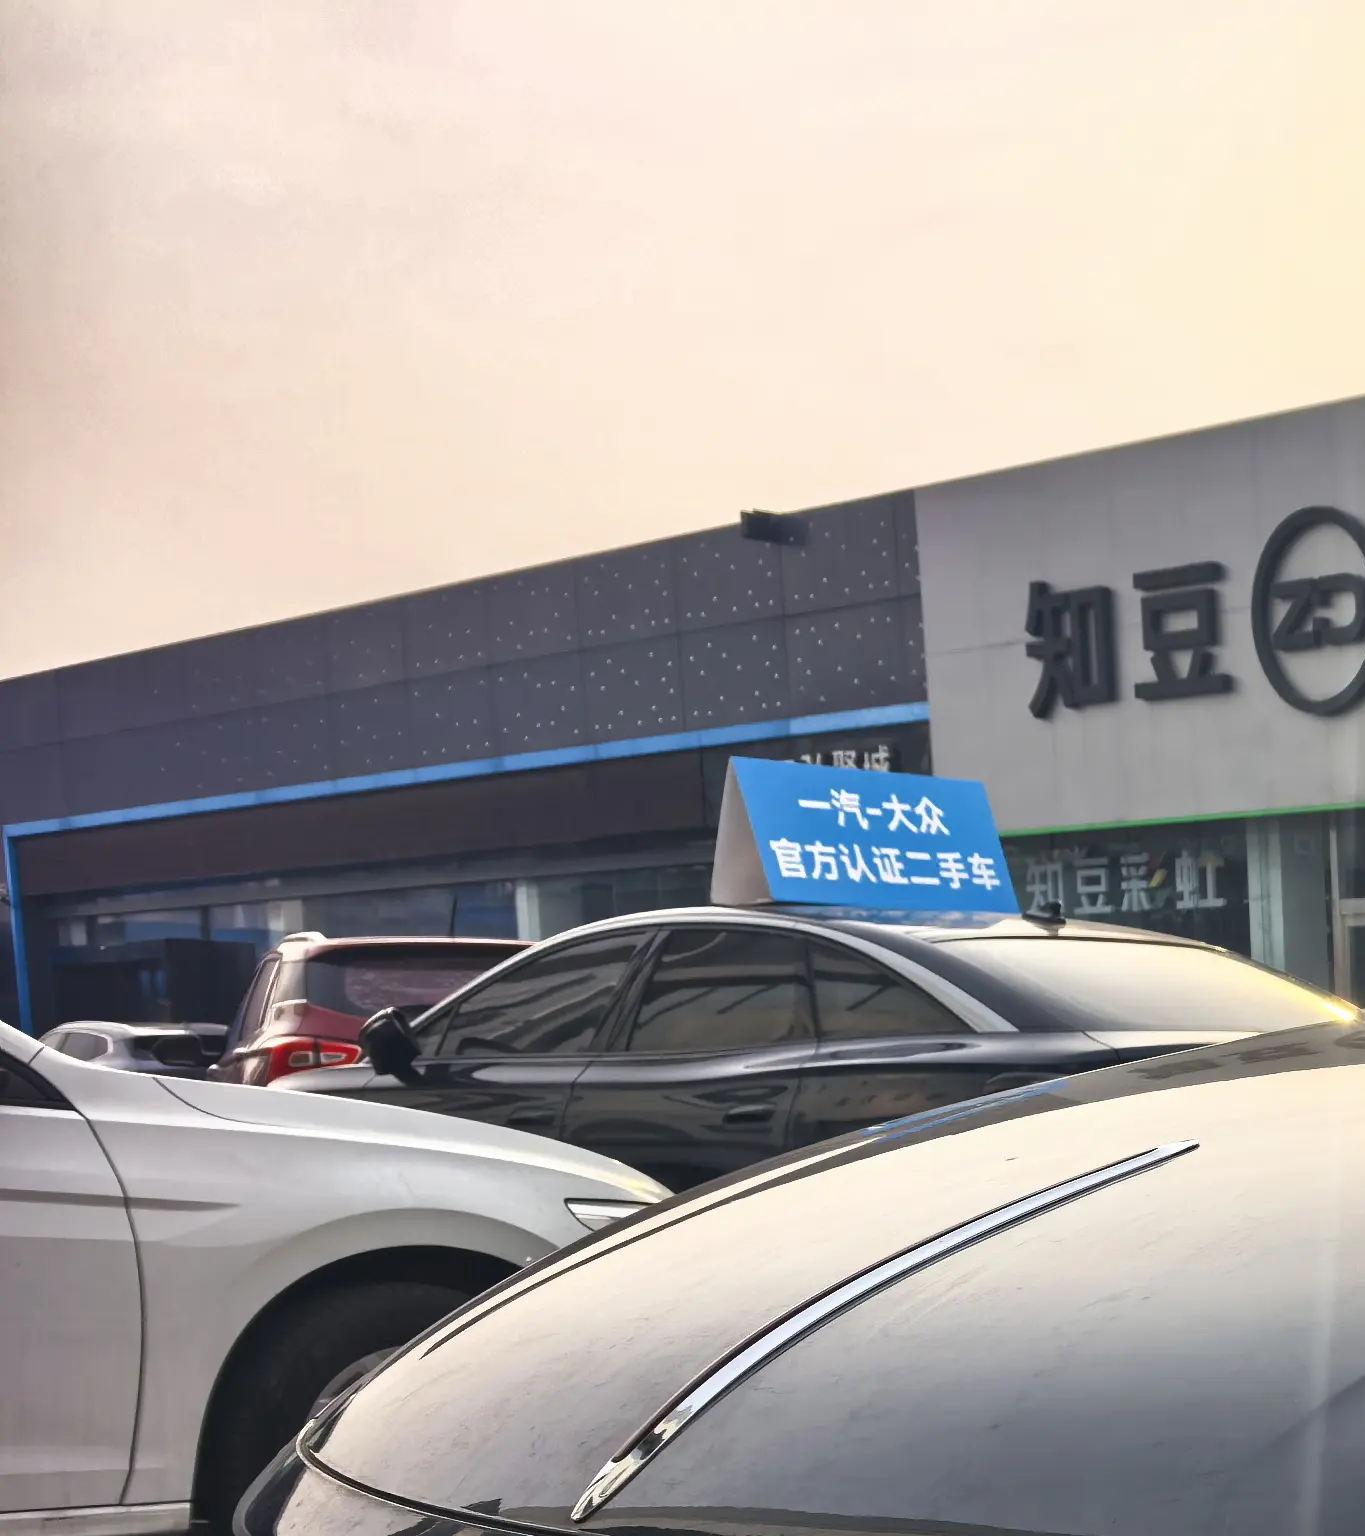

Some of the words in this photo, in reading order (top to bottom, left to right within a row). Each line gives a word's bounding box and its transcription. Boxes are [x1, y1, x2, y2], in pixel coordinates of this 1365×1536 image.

[1025, 560, 1234, 720] 知豆
[797, 789, 950, 836] 一汽-大众
[769, 837, 1001, 891] 官方认证二手车
[1026, 850, 1228, 915] 知豆彩虹
